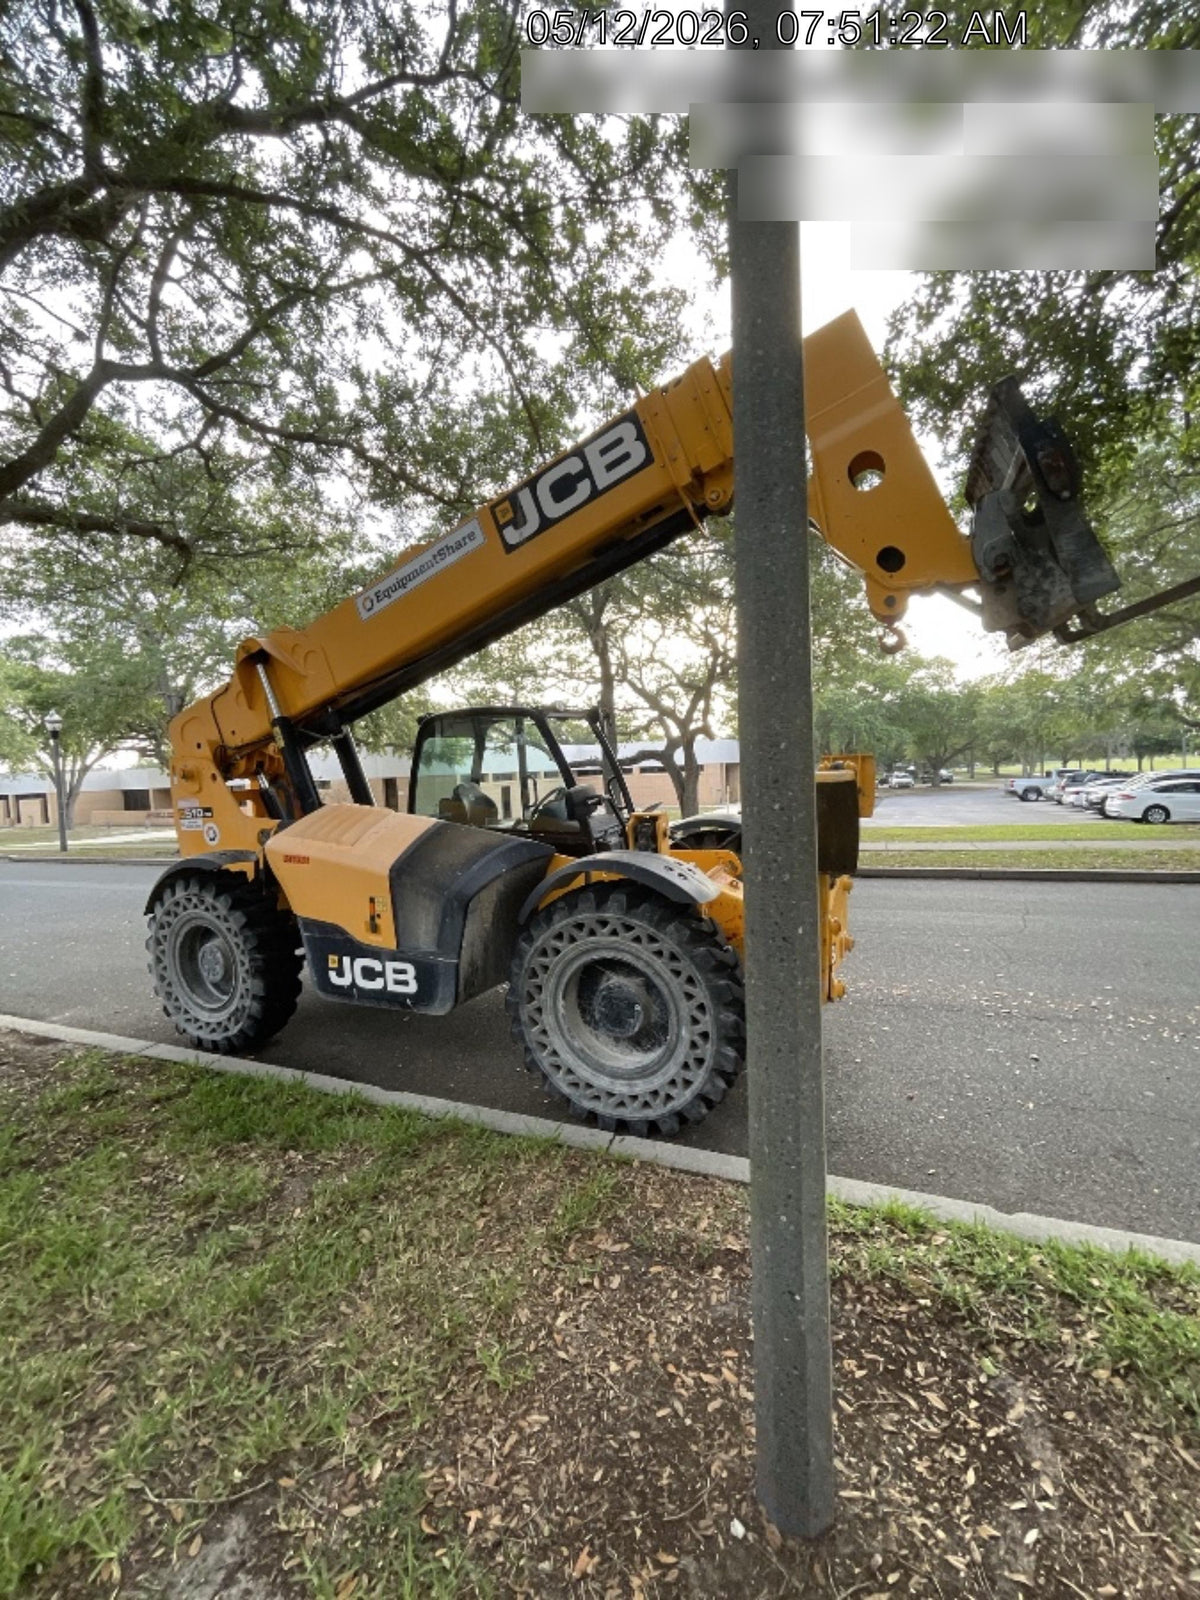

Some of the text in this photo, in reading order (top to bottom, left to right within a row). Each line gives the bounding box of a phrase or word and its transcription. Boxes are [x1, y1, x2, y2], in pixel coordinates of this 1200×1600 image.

[501, 421, 647, 545] JCB
[374, 530, 476, 604] EquipmentShare
[328, 955, 418, 994] JCB
